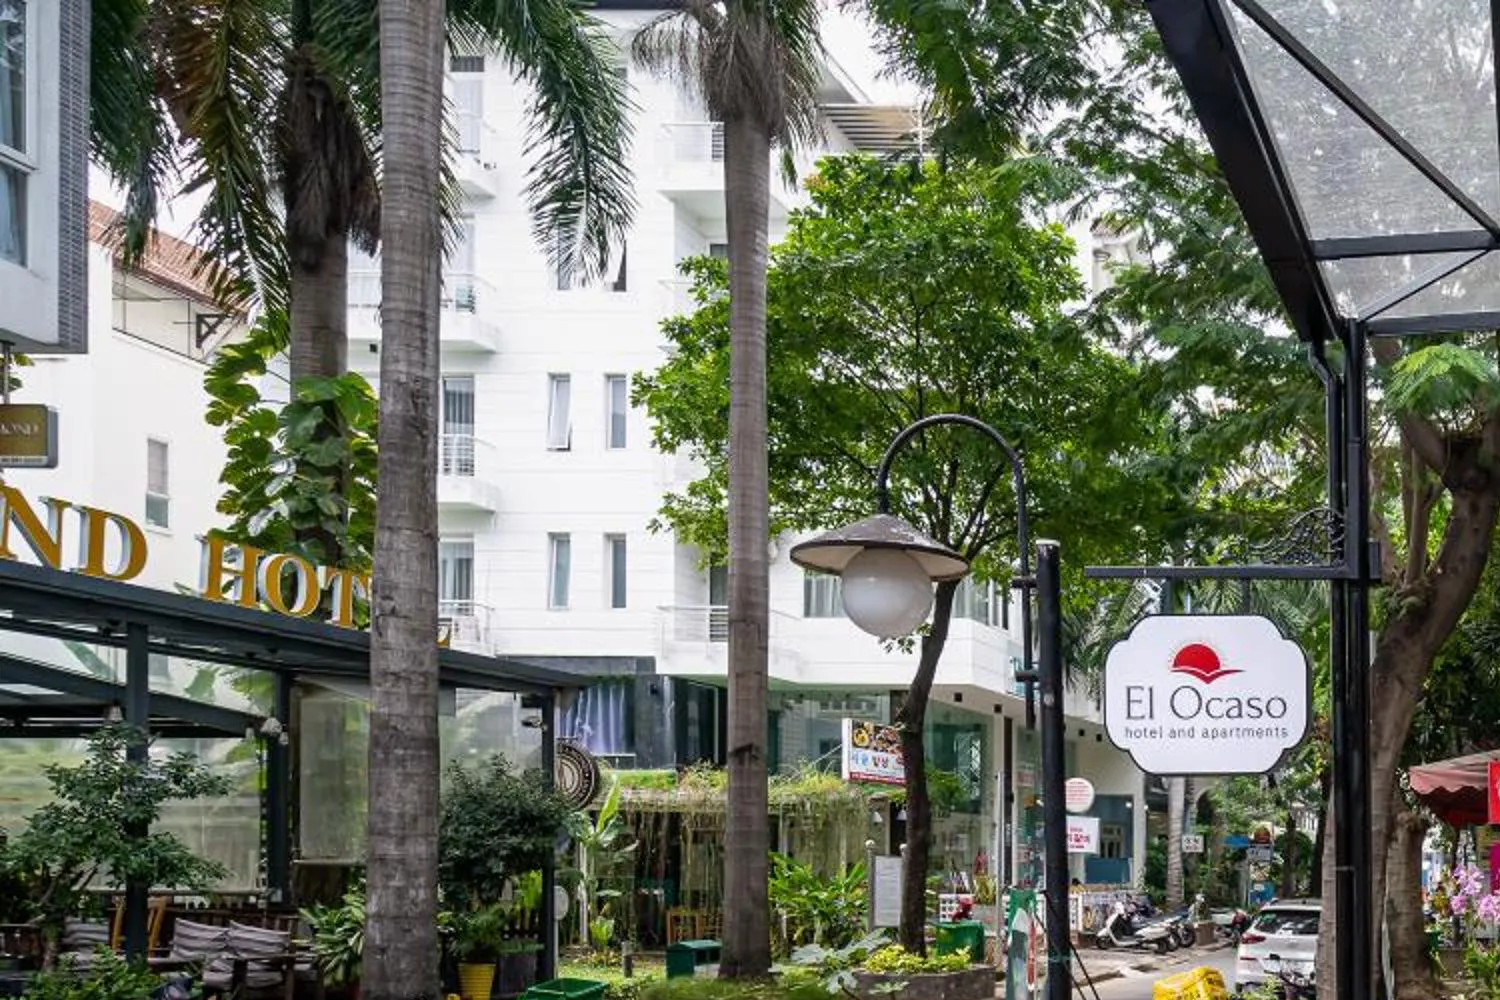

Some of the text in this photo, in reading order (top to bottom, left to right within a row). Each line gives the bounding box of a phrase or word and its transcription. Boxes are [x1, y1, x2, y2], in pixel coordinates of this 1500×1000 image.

[196, 530, 450, 648] HOT
[1126, 684, 1288, 721] El Ocaso
[1125, 725, 1289, 741] hotel and apartments
